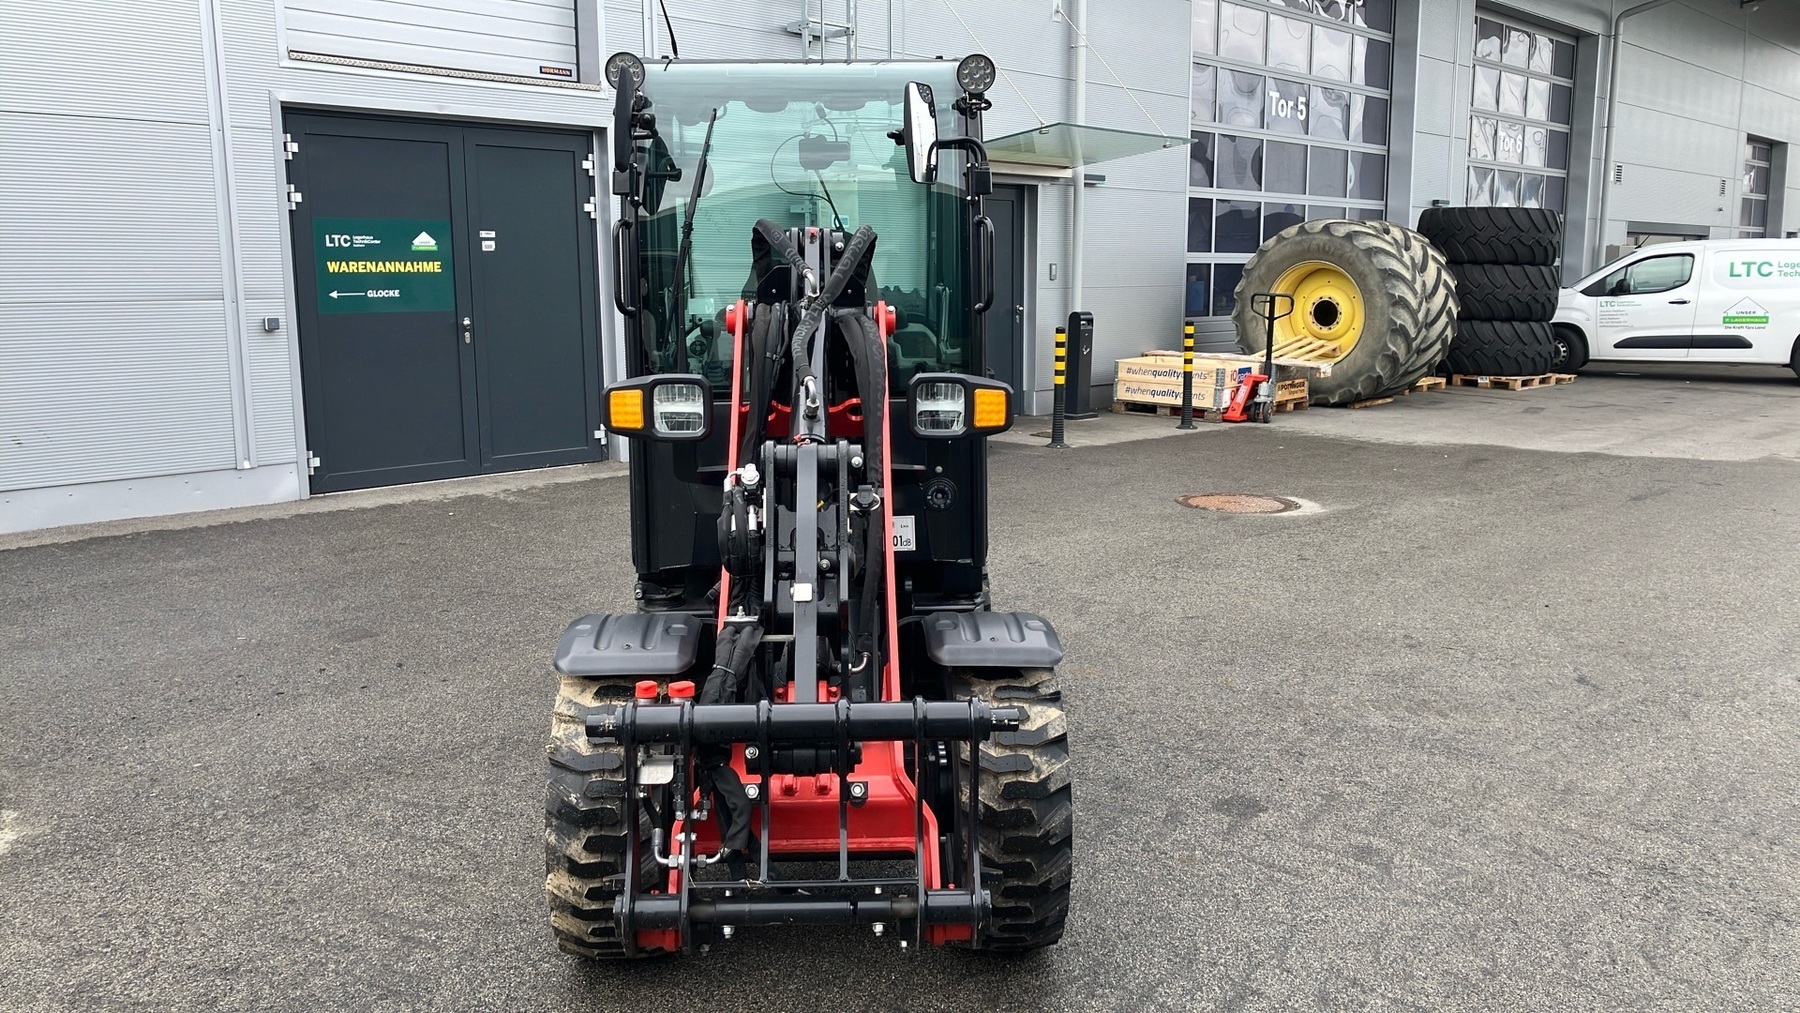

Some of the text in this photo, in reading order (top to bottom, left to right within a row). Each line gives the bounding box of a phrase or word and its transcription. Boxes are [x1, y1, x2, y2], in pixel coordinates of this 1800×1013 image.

[1269, 91, 1307, 121] Tor 5
[1499, 130, 1523, 154] Tor 6
[325, 234, 351, 248] LTC
[326, 261, 442, 273] WARENANNAHME
[1729, 261, 1774, 278] LTC
[367, 289, 400, 298] GLOCKE
[1599, 300, 1616, 308] LTC
